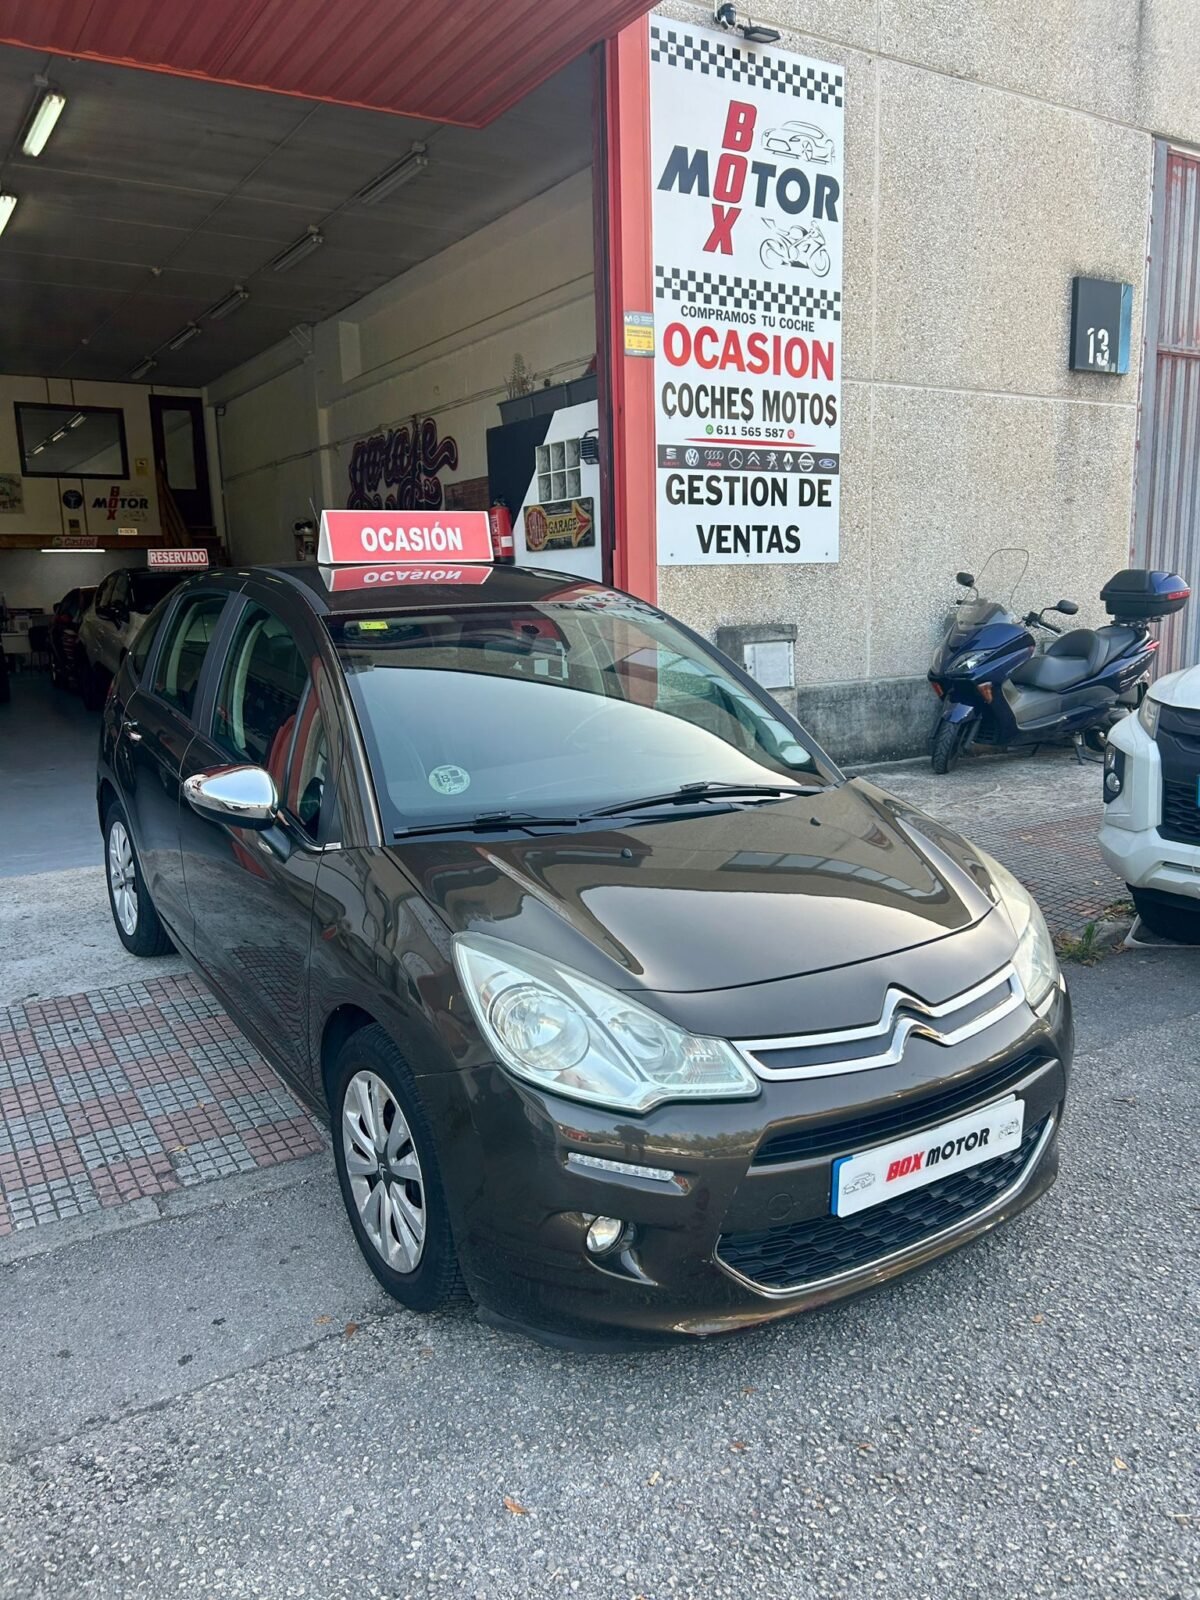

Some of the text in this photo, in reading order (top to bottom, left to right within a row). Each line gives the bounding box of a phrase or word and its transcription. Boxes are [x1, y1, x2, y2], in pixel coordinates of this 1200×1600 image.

[702, 100, 757, 255] BOX
[680, 305, 815, 332] COMPRAMOS TU COCHE
[663, 322, 834, 381] OCASION
[1087, 327, 1109, 366] 13
[661, 381, 838, 428] COCHES MOTOS
[716, 425, 785, 438] 611 565 587
[665, 473, 832, 507] GESTION DE
[360, 521, 463, 552] OCASIÓN
[548, 517, 577, 535] GARAGE
[696, 524, 801, 554] VENTAS
[150, 551, 206, 563] RESERVADO
[885, 1127, 990, 1182] BOX MOTOR
